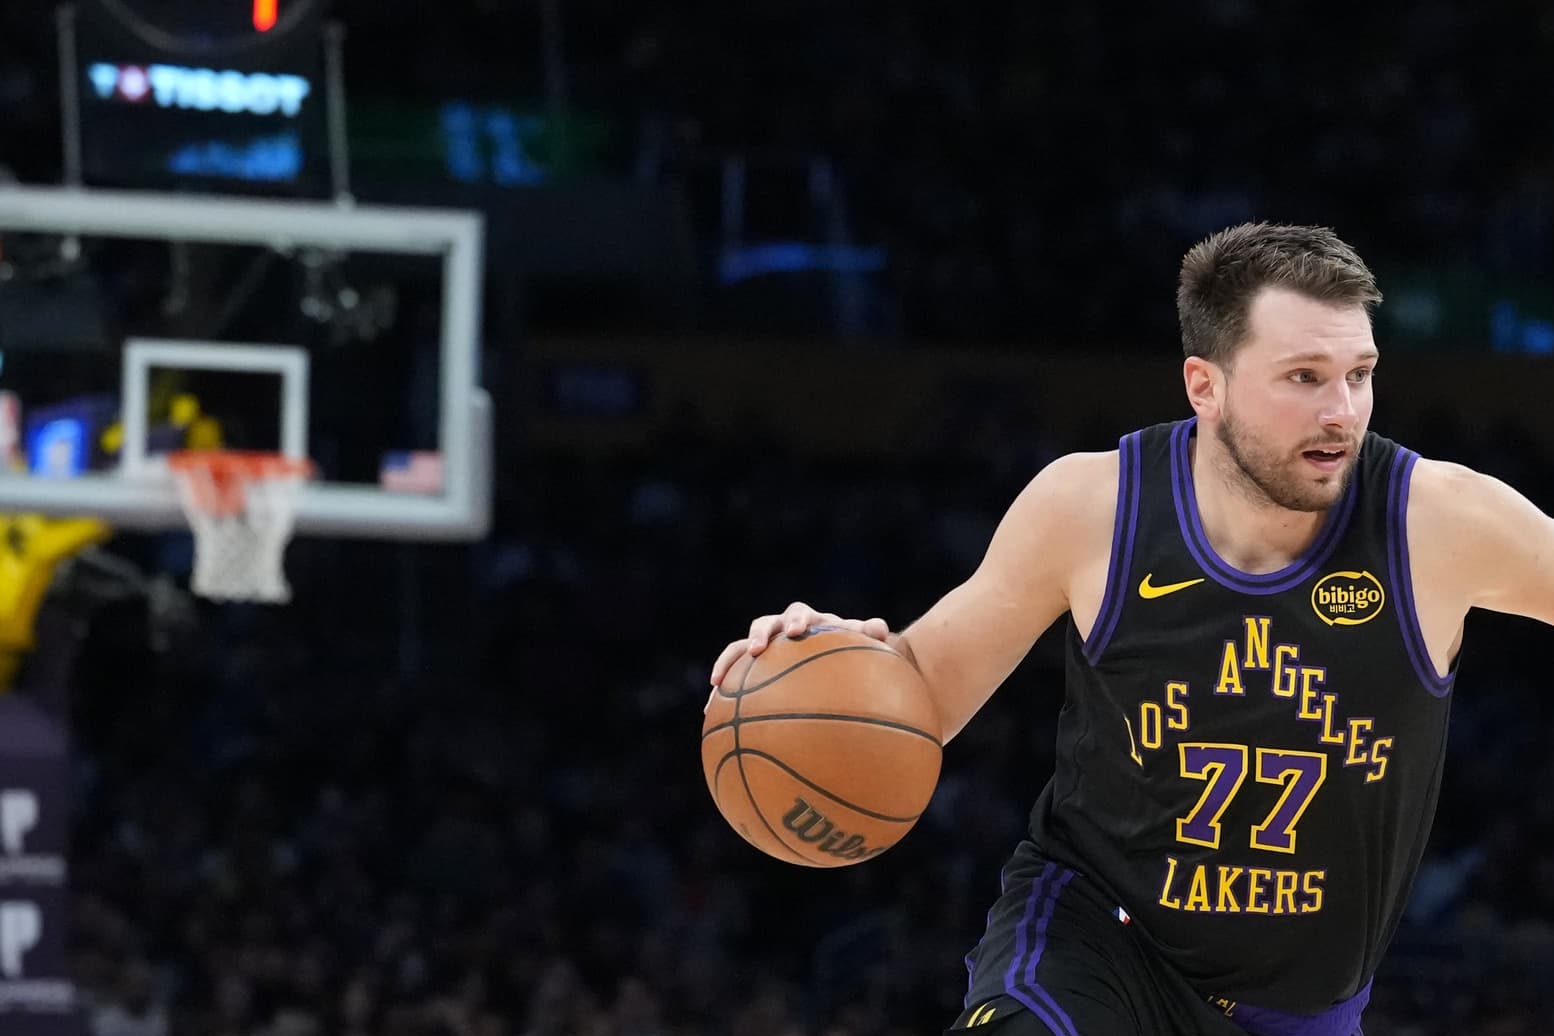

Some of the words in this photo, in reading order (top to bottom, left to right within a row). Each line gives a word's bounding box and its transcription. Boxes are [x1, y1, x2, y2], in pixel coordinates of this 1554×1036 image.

[1318, 585, 1380, 609] bibigo
[1214, 615, 1395, 784] ANGELES
[782, 795, 887, 860] Wils
[1176, 742, 1328, 855] 77
[1158, 857, 1327, 914] LAKERS
